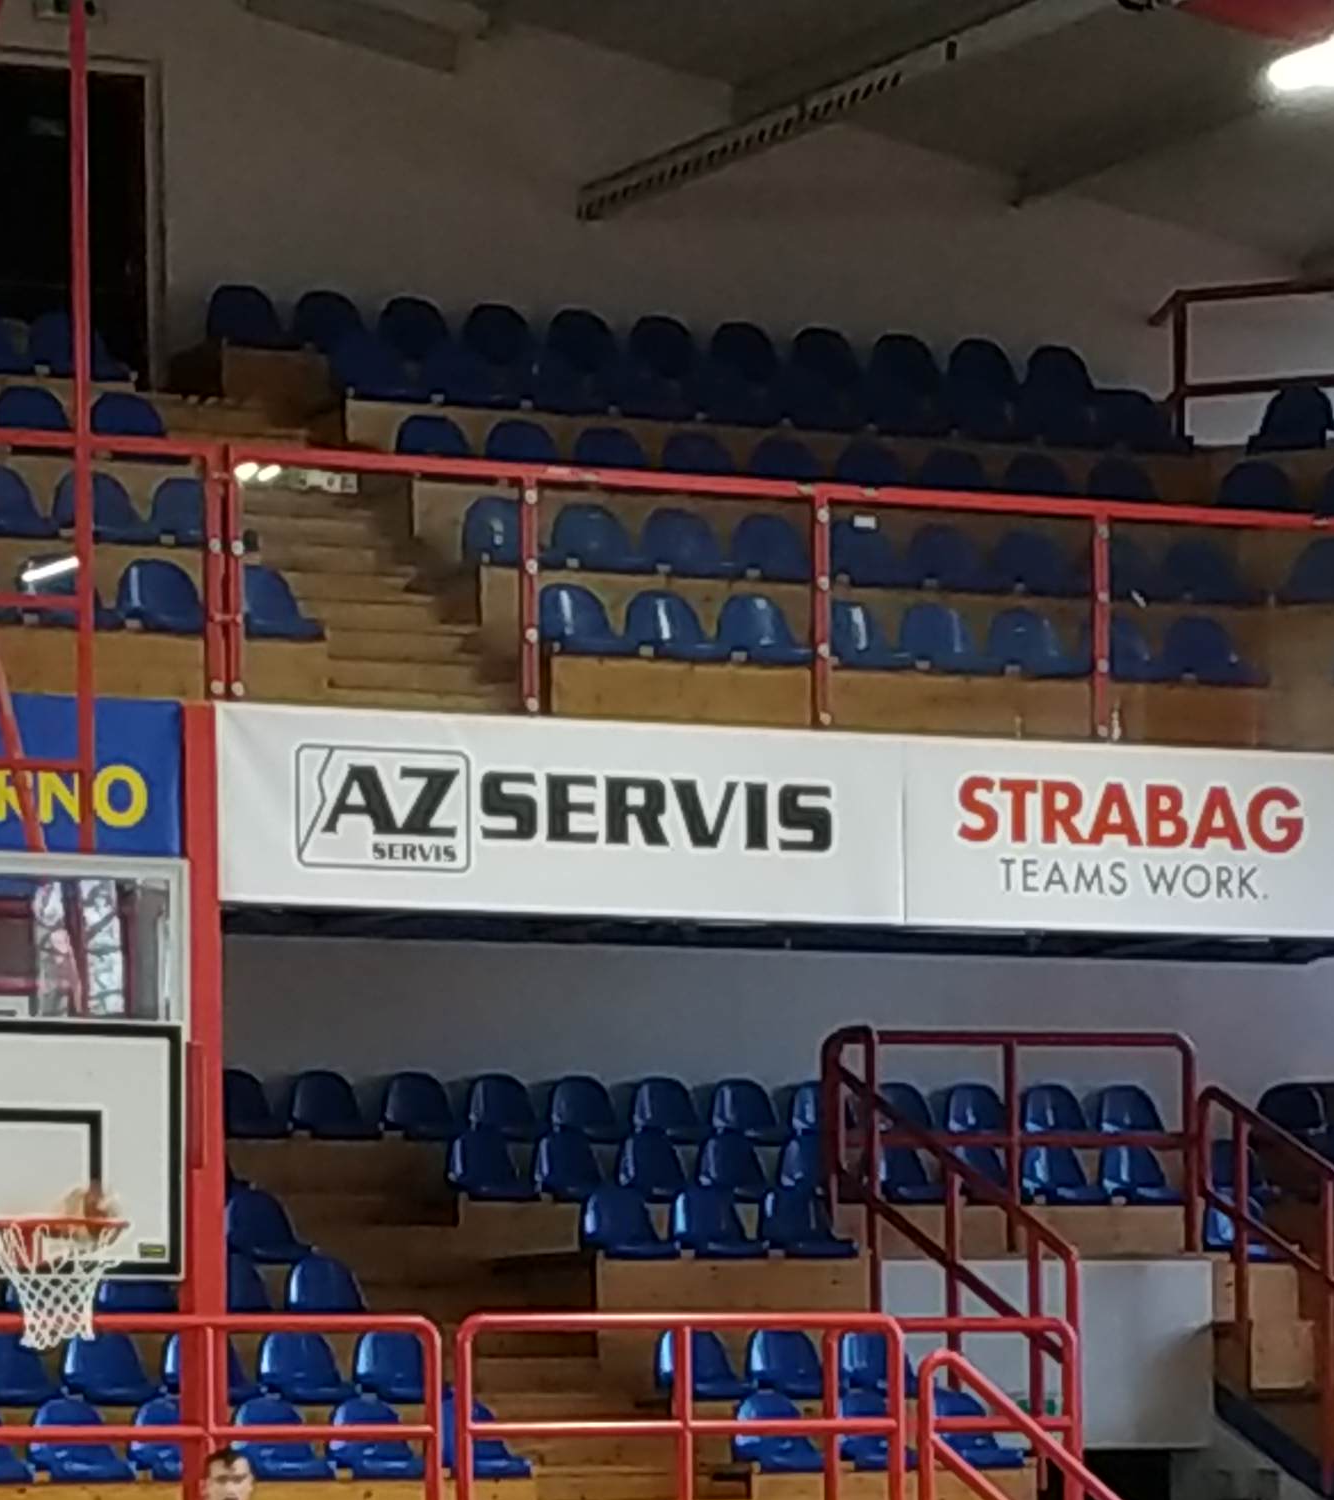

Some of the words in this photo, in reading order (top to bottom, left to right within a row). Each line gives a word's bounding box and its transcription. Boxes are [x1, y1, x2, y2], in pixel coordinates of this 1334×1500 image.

[320, 763, 461, 838] AZ
[480, 769, 833, 853] SERVIS
[957, 775, 1304, 854] STRABAG
[372, 841, 457, 863] SERVIS
[1000, 857, 1128, 896] TEAMS
[1144, 862, 1269, 900] WORK.
